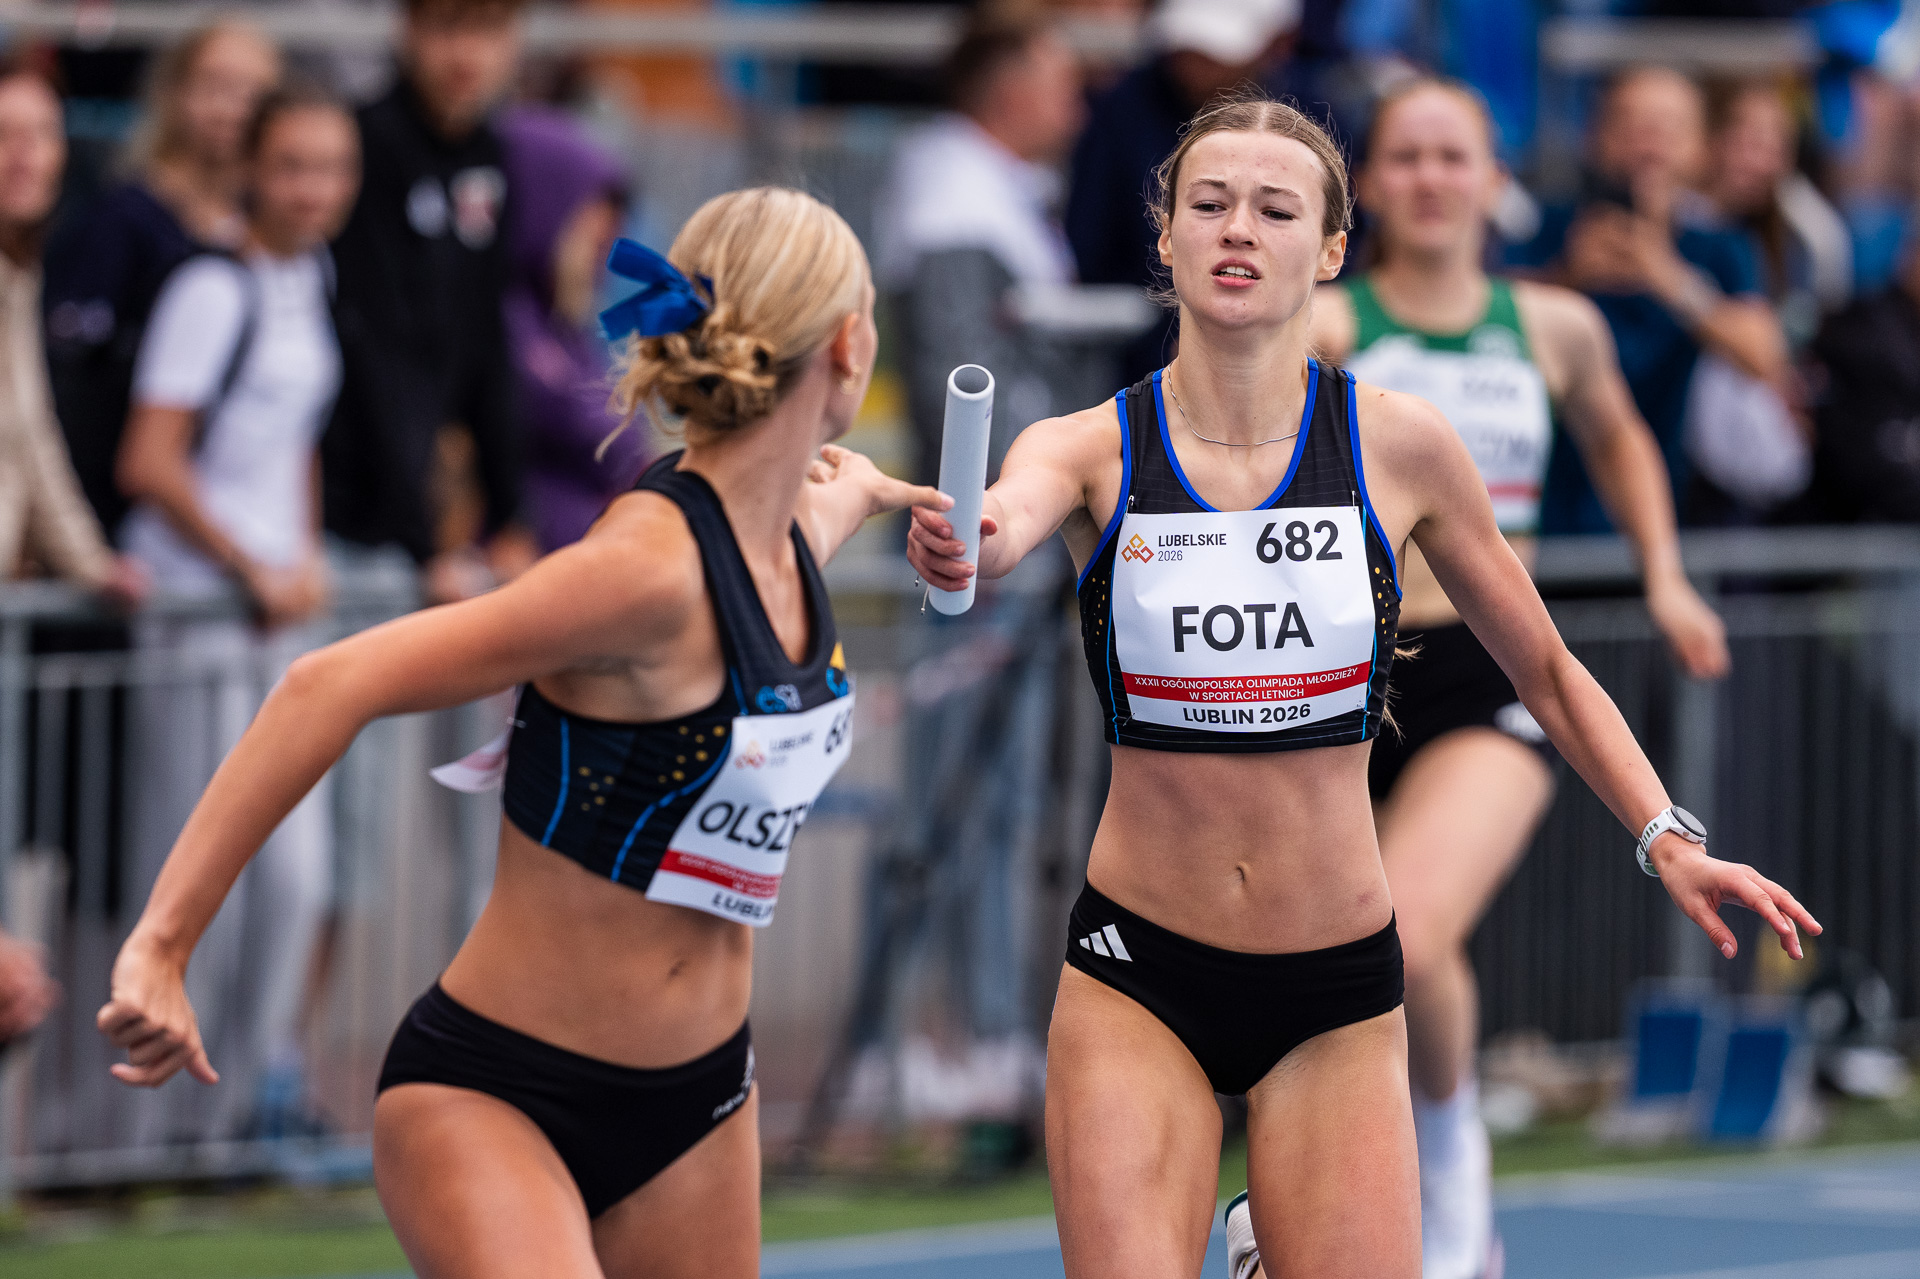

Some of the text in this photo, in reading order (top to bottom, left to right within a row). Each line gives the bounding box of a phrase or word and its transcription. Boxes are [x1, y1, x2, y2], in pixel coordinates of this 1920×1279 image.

[1157, 533, 1228, 547] LUBELSKIE
[1255, 519, 1343, 565] 682
[1157, 550, 1184, 562] 2026
[1172, 601, 1315, 653] FOTA
[1134, 667, 1359, 690] XXXII OGÓLNOPOLSKA OLIMPIADA MŁODZIEŻY
[1189, 688, 1304, 701] W SPORTACH LETNICH
[1182, 703, 1311, 725] LUBLIN 2026
